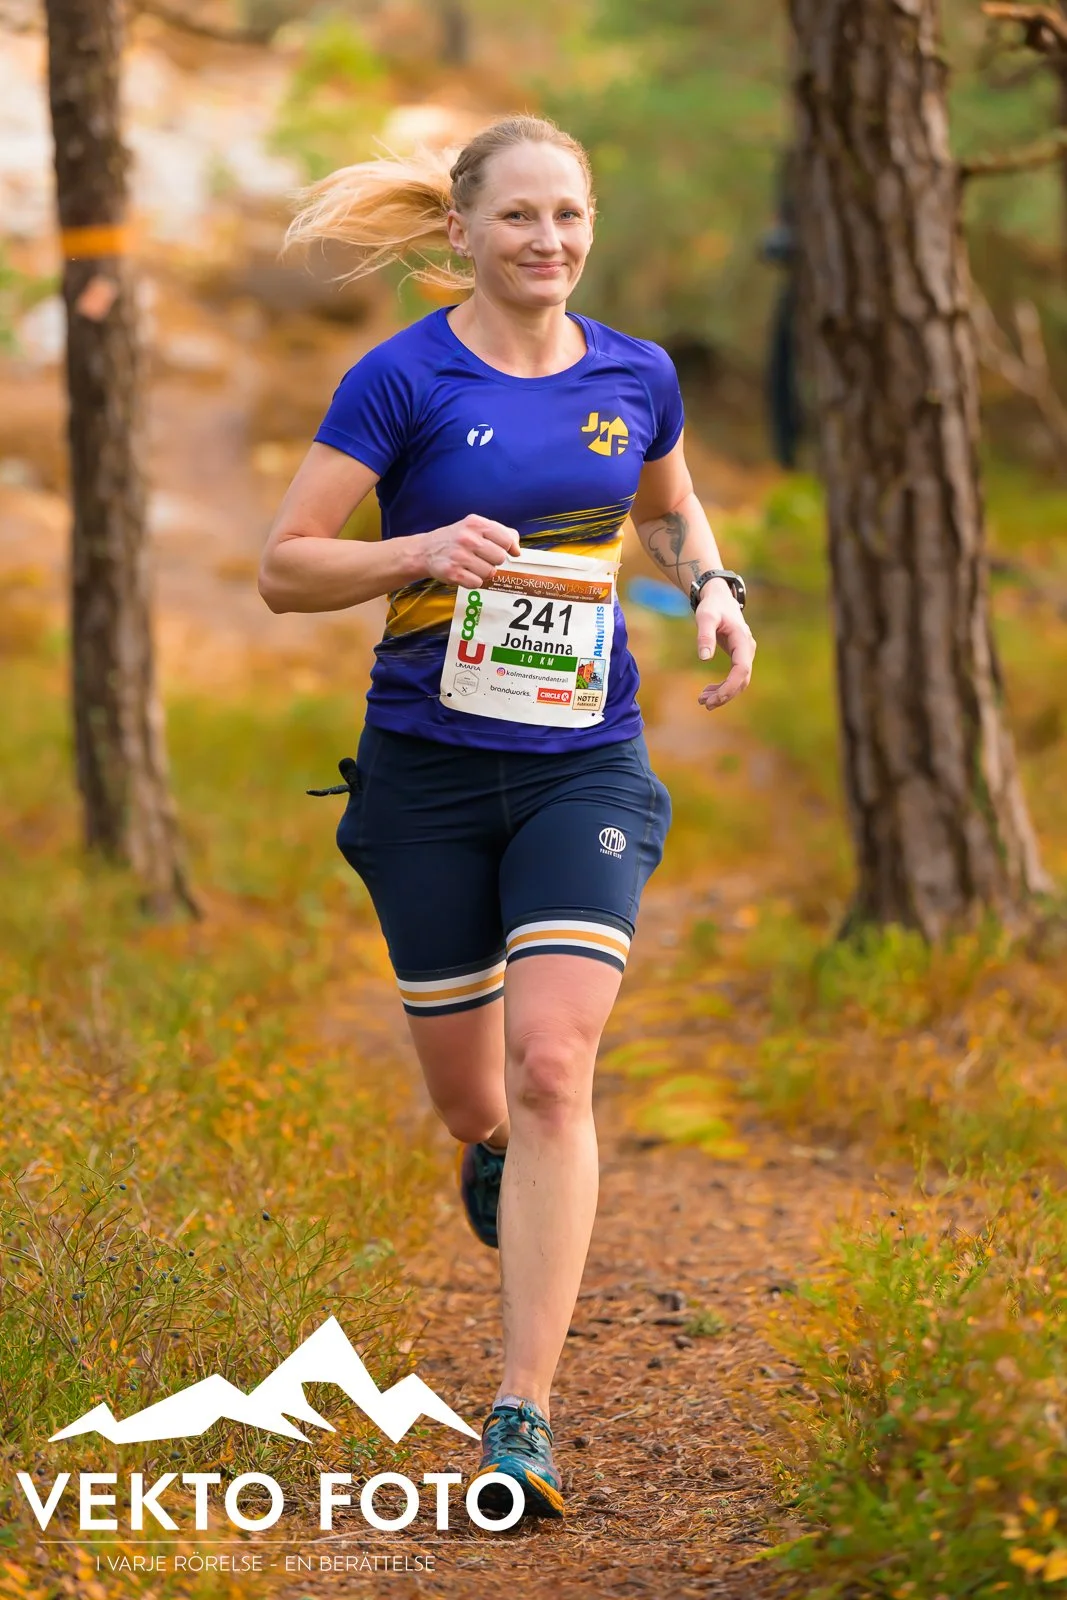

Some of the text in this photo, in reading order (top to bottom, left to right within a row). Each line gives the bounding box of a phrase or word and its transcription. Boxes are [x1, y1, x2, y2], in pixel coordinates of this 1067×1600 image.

[461, 590, 483, 641] coop
[508, 598, 573, 636] 241
[593, 605, 605, 658] Aktivitus
[501, 632, 573, 656] Johanna
[455, 662, 481, 672] UMARA
[520, 653, 554, 667] 10 KM
[506, 669, 569, 683] kolmardsrundantrail
[540, 691, 561, 700] CIRCLE
[577, 695, 599, 703] NØTTE
